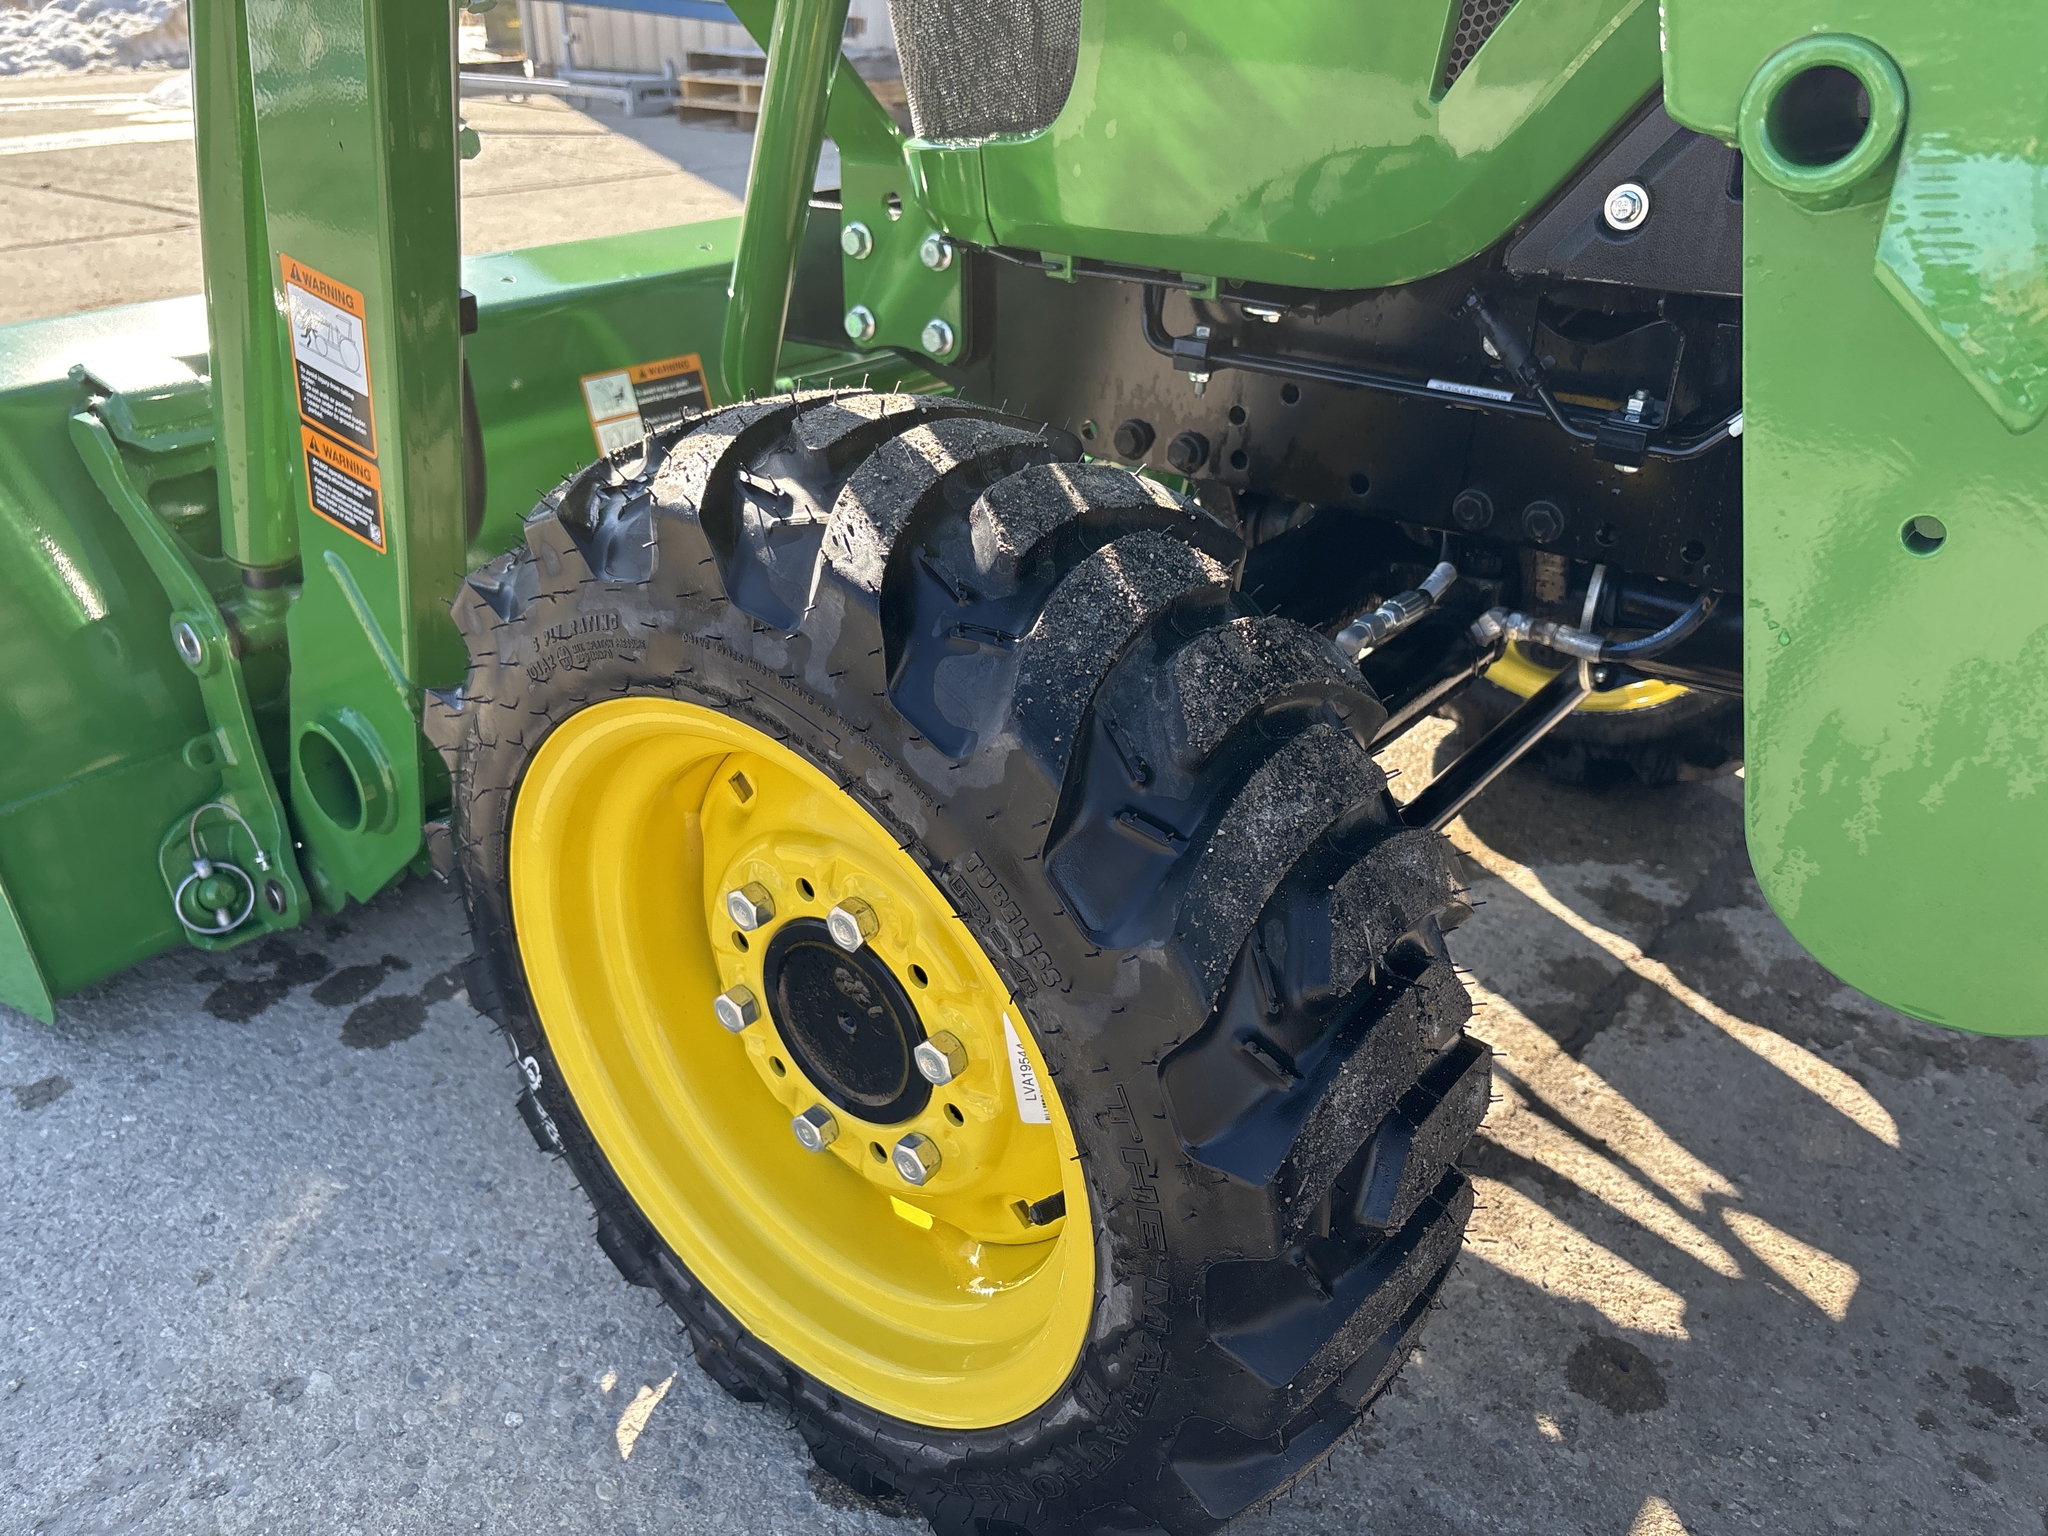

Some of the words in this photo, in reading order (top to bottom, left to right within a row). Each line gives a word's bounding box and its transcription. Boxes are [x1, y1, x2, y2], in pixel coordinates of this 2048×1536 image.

[302, 271, 354, 309] WARNING
[318, 374, 329, 387] injury
[649, 359, 690, 375] WARNING
[322, 444, 371, 482] WARNING
[569, 614, 620, 636] RATING
[682, 632, 711, 650] DRIVE
[747, 658, 774, 678] MUST
[897, 767, 936, 808] POINTS
[965, 851, 1063, 988] TUBELESS
[1106, 1083, 1168, 1253] THE
